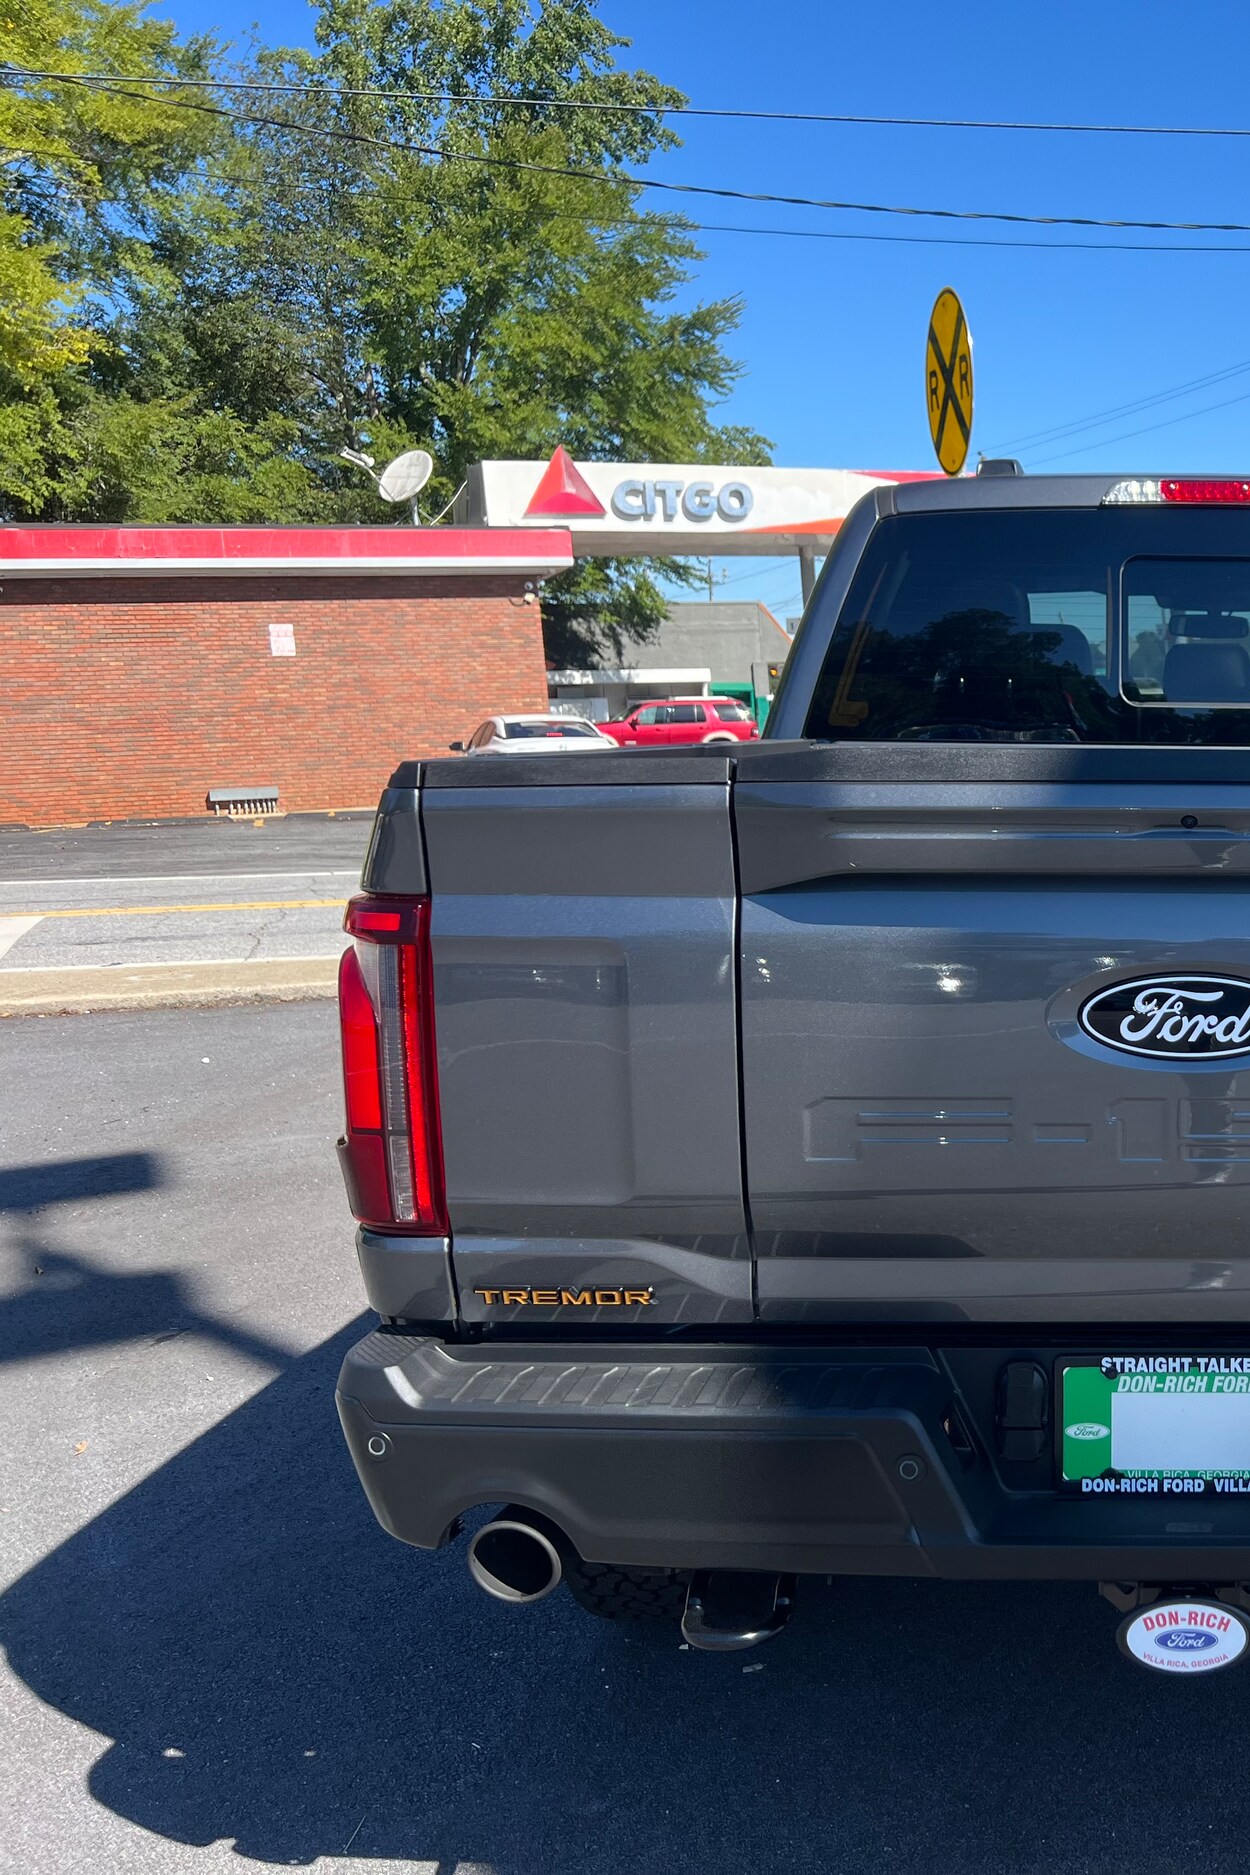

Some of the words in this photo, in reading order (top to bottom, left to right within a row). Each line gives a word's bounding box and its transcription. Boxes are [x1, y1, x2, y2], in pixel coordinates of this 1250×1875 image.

[929, 369, 940, 413] R
[958, 353, 970, 400] R
[611, 479, 755, 522] CITGO
[474, 1286, 653, 1306] TREMOR
[1101, 1356, 1193, 1374] STRAIGHT
[1117, 1375, 1209, 1393] DON-RICH
[1081, 1478, 1158, 1493] DON-RICH
[1163, 1478, 1205, 1493] FORD
[1142, 1610, 1232, 1632] DON-RICH
[1167, 1632, 1206, 1648] Ford
[1143, 1652, 1165, 1666] VILLA
[1166, 1660, 1189, 1669] RICA,
[1191, 1653, 1229, 1668] GEORGIA
